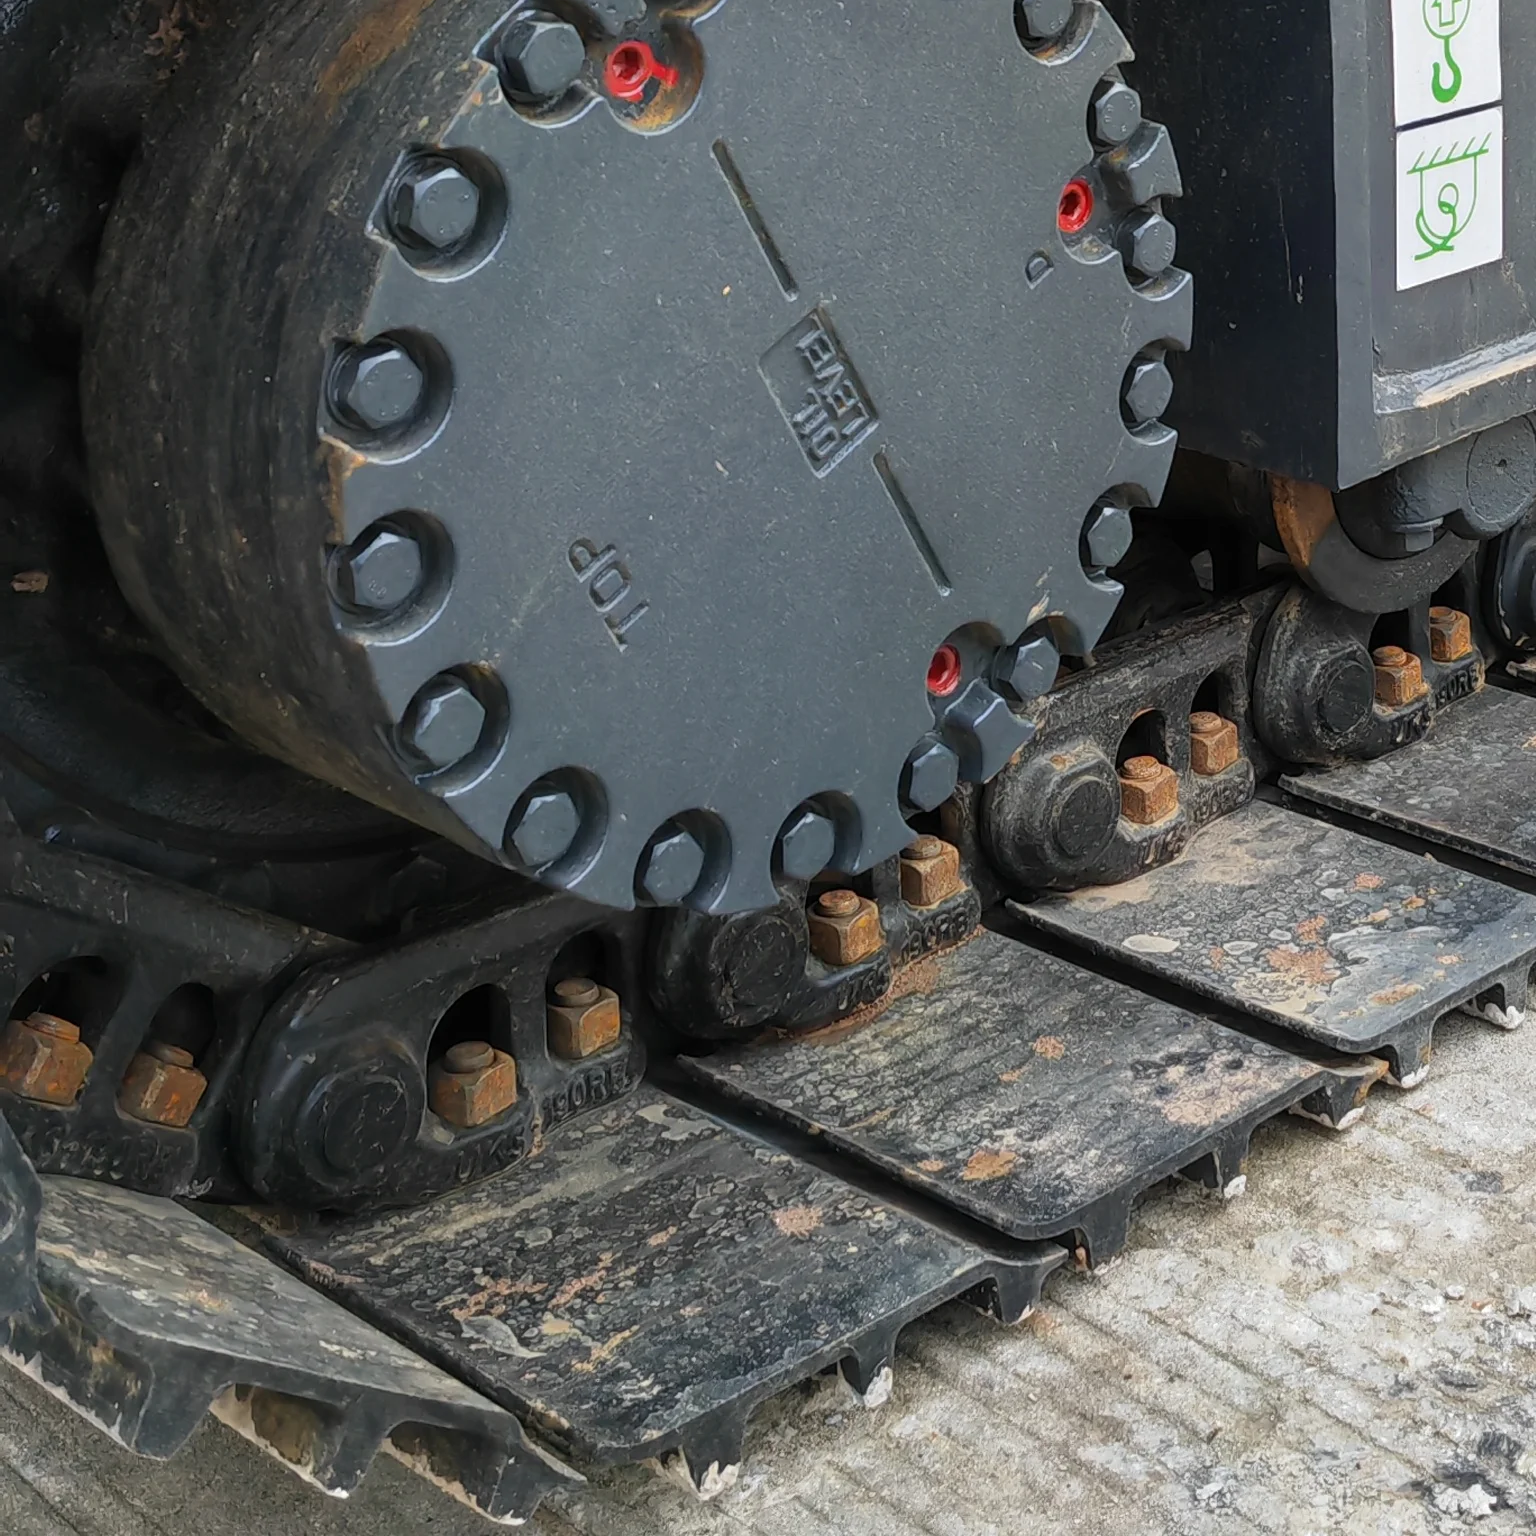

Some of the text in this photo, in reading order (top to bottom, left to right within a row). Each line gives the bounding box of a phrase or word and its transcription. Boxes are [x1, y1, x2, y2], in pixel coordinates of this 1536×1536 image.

[792, 386, 839, 461] OIL
[796, 314, 871, 441] LEVEL
[566, 537, 649, 653] TOP
